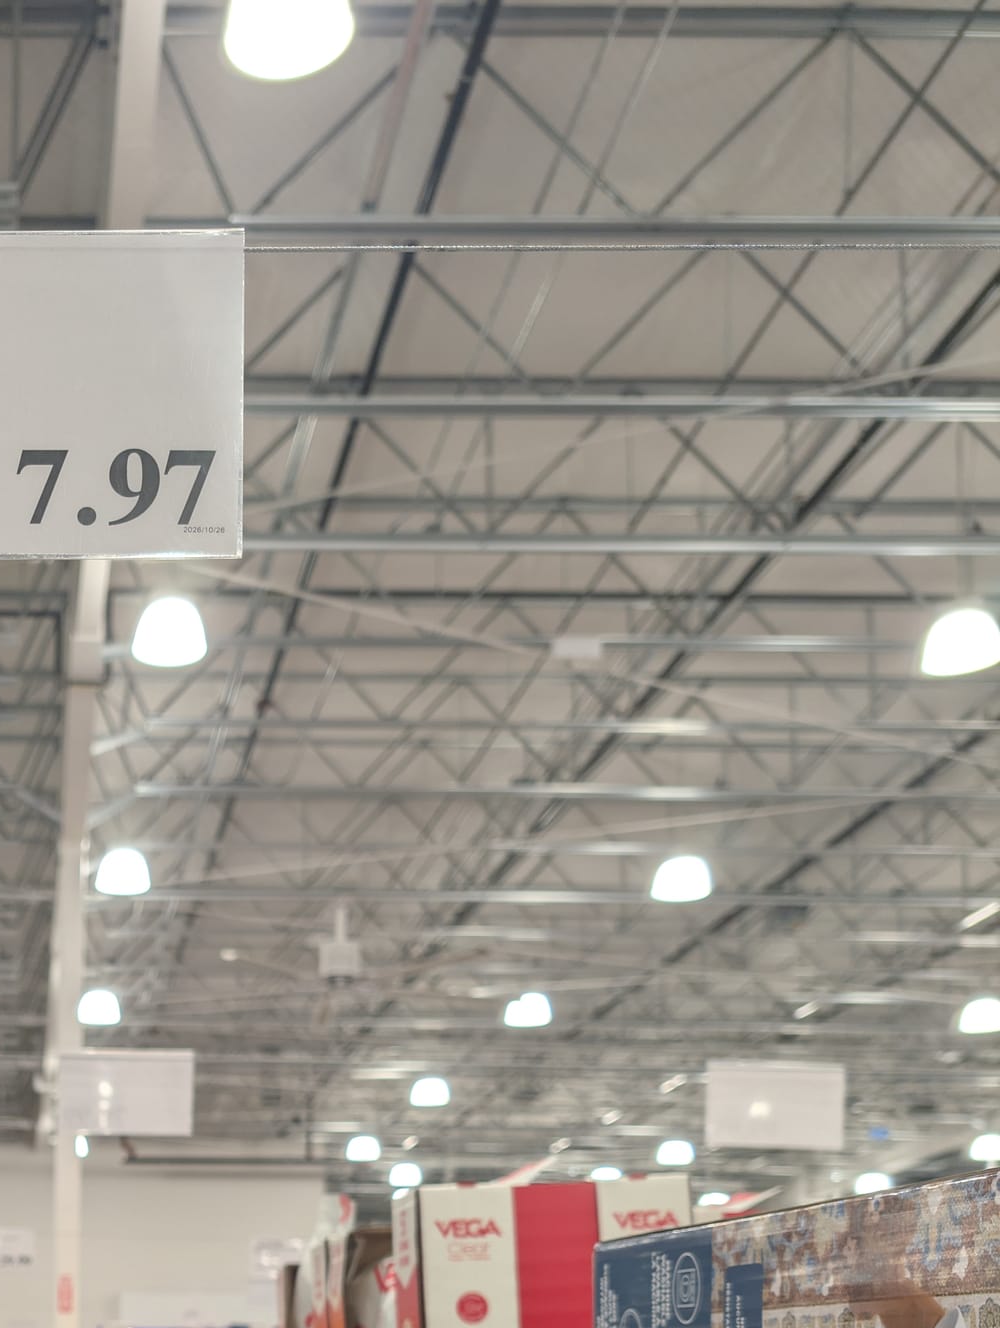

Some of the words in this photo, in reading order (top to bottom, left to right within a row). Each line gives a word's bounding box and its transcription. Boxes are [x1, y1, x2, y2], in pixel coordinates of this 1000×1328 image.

[16, 448, 217, 526] 7.97
[434, 1218, 502, 1239] VEGA
[614, 1210, 679, 1231] VEGA
